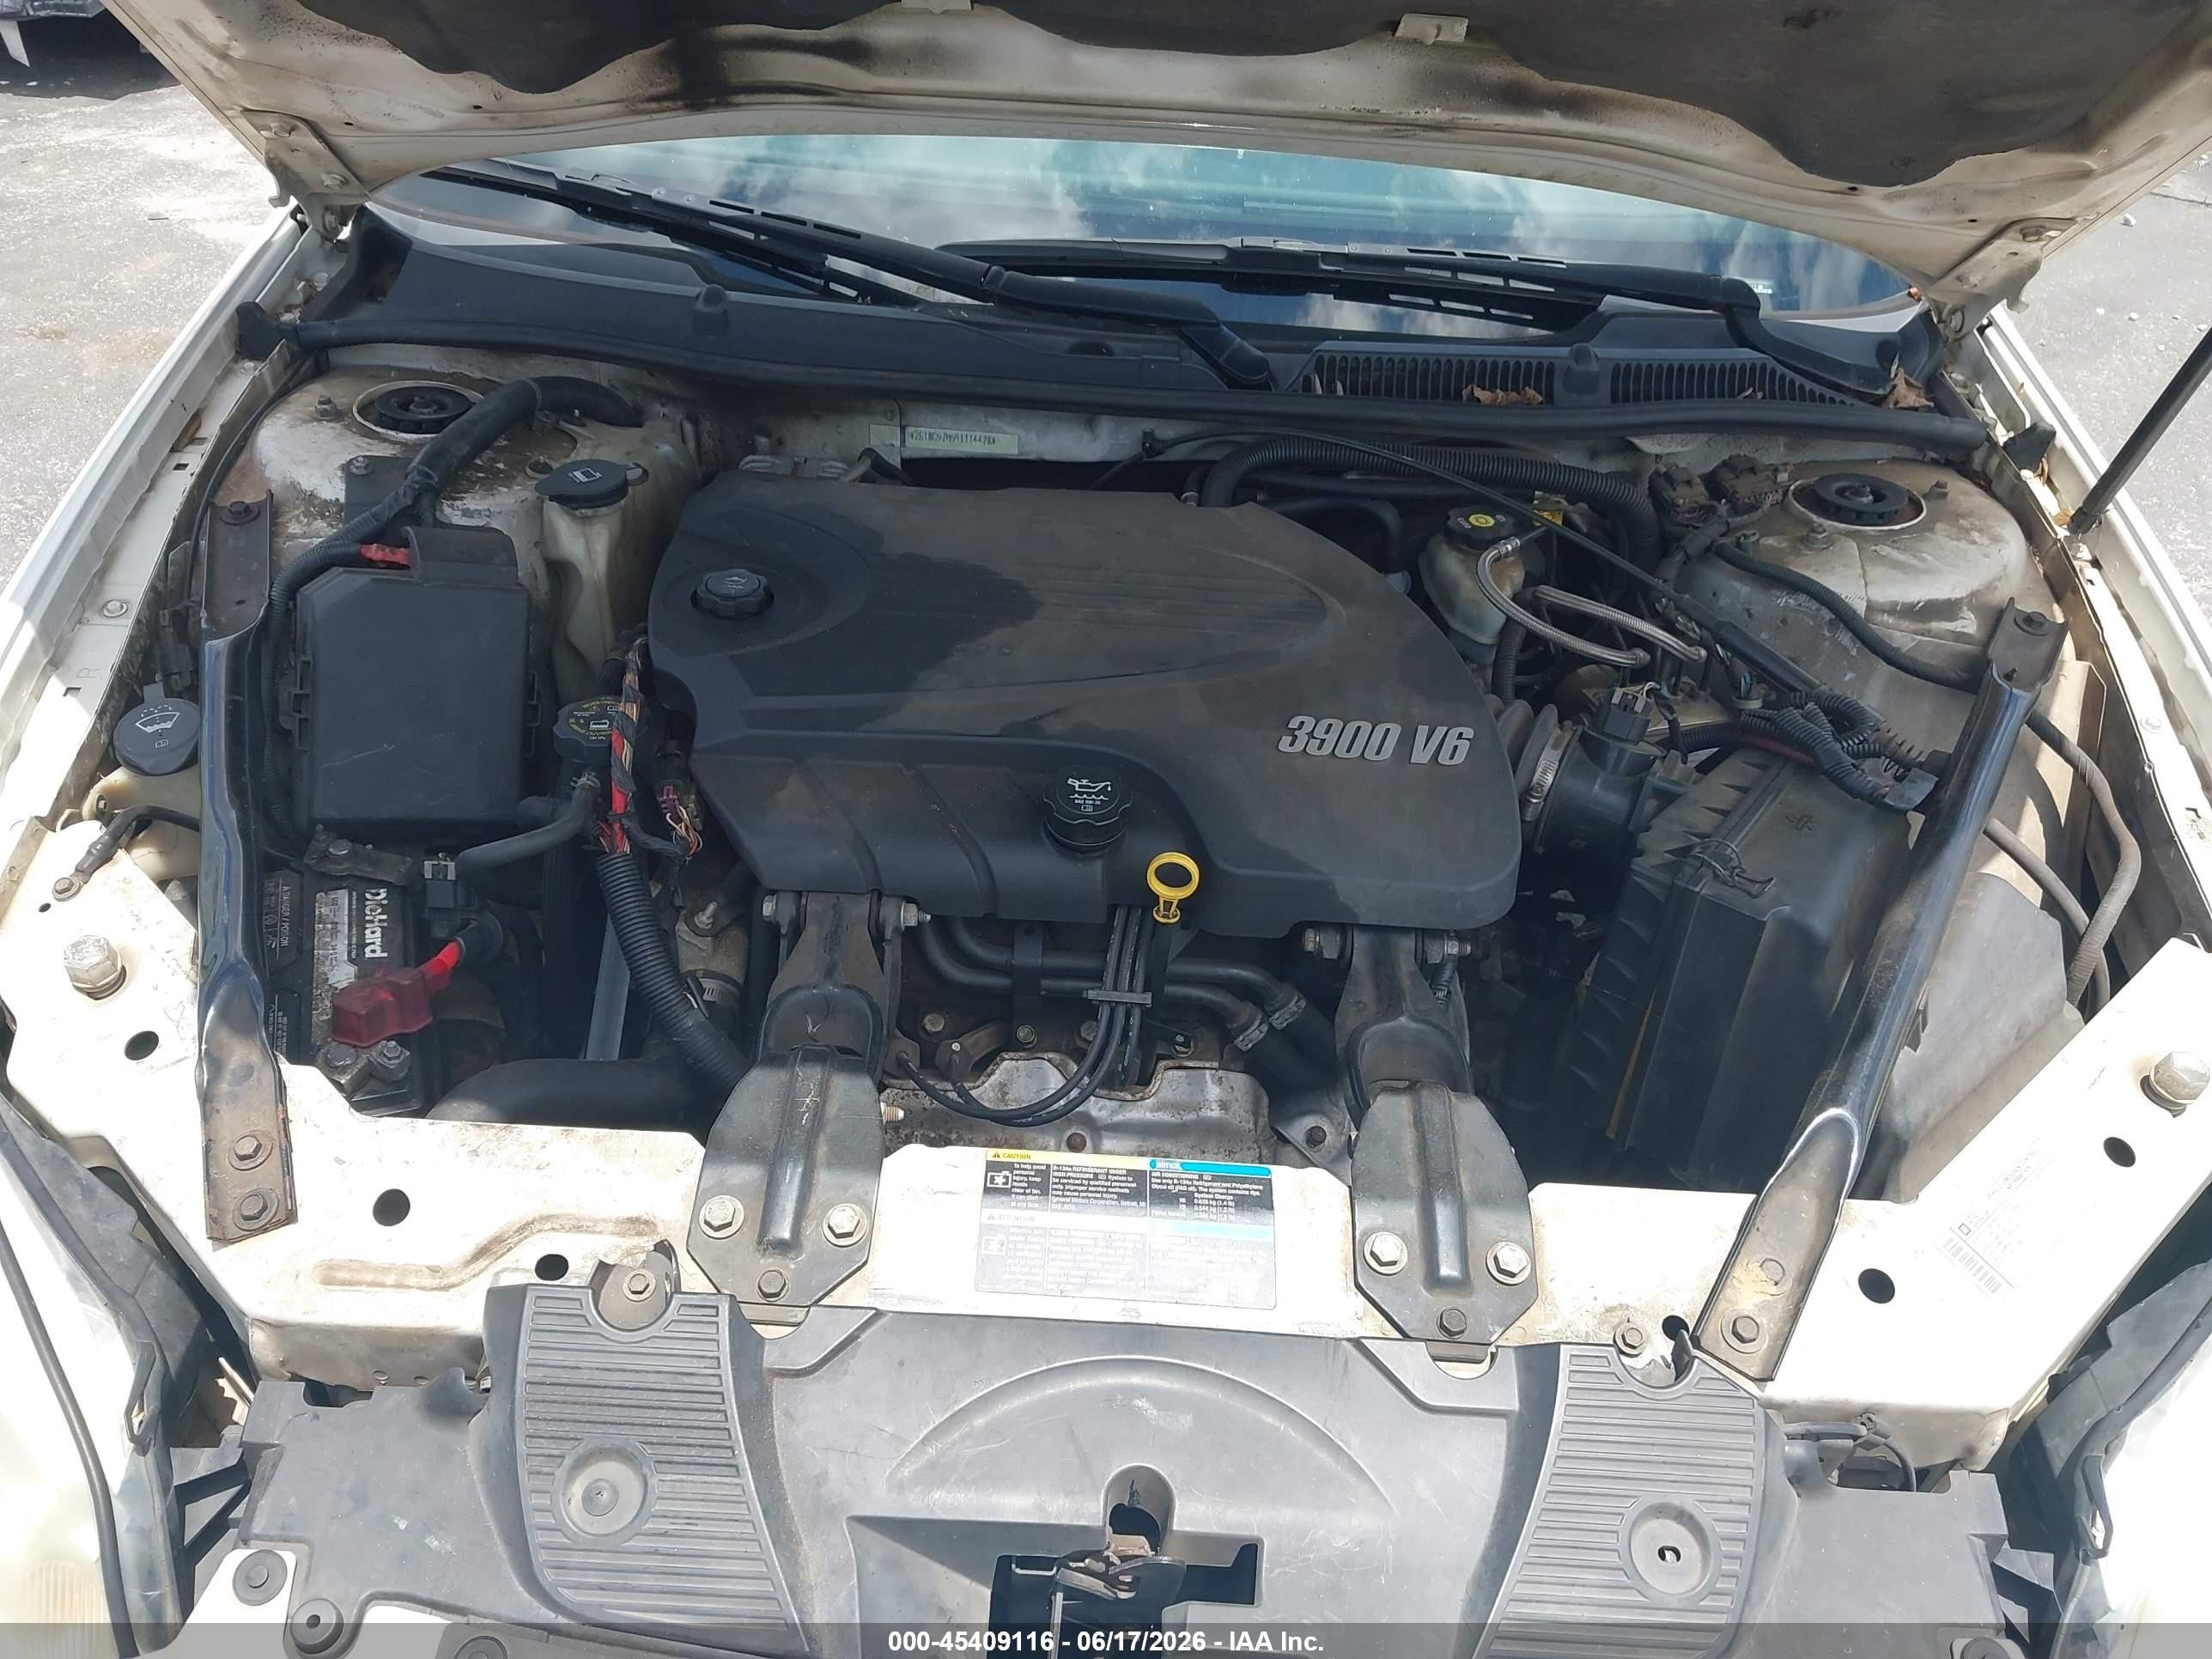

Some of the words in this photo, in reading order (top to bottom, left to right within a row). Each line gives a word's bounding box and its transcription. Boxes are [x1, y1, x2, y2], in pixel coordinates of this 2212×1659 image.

[1279, 715, 1401, 761] 3900
[1410, 725, 1474, 766] V6
[282, 891, 290, 917] DANGER
[364, 888, 388, 958] DieHard
[280, 922, 289, 947] POISON
